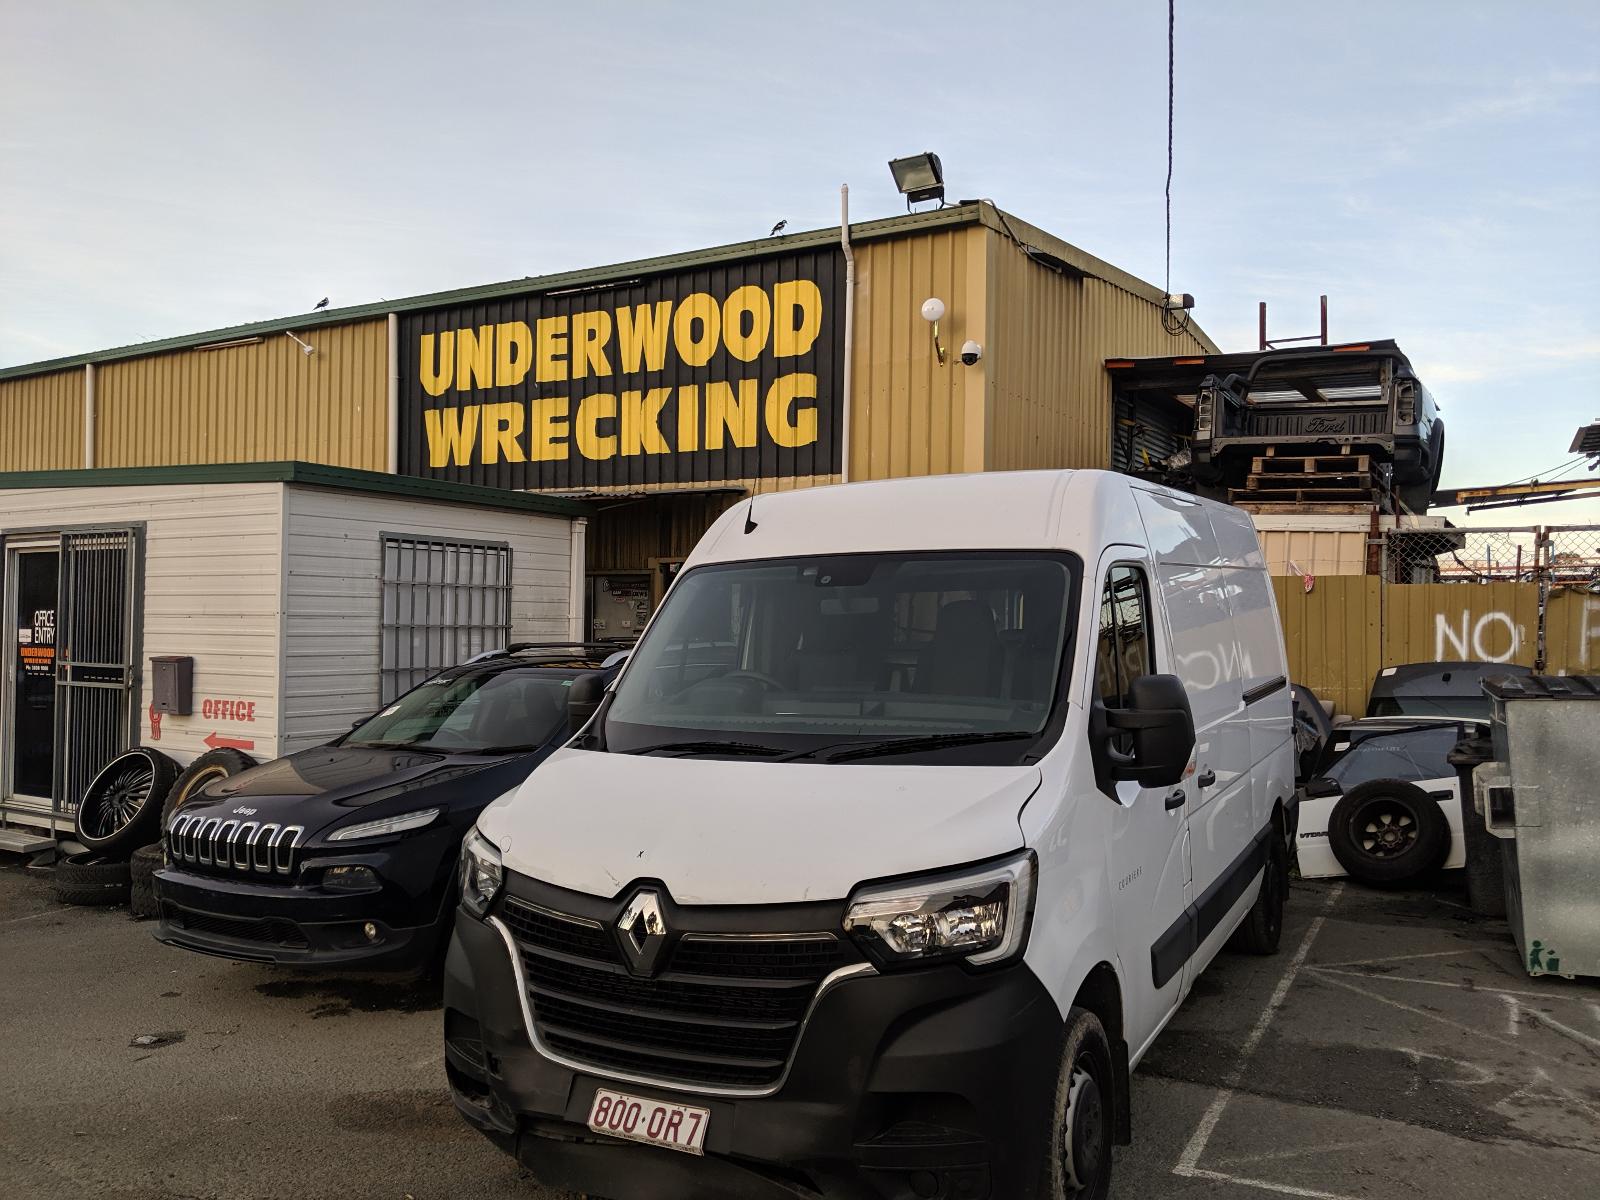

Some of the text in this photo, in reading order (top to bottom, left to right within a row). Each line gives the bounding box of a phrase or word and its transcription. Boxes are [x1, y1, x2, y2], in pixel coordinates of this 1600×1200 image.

[420, 280, 822, 396] UNDERWOOD
[424, 373, 818, 468] WRECKING
[1304, 416, 1346, 433] Ford
[34, 610, 55, 627] OFFICE
[34, 627, 55, 644] ENTRY
[1435, 608, 1521, 663] NO
[202, 698, 256, 722] OFFICE
[232, 805, 258, 817] Jeep
